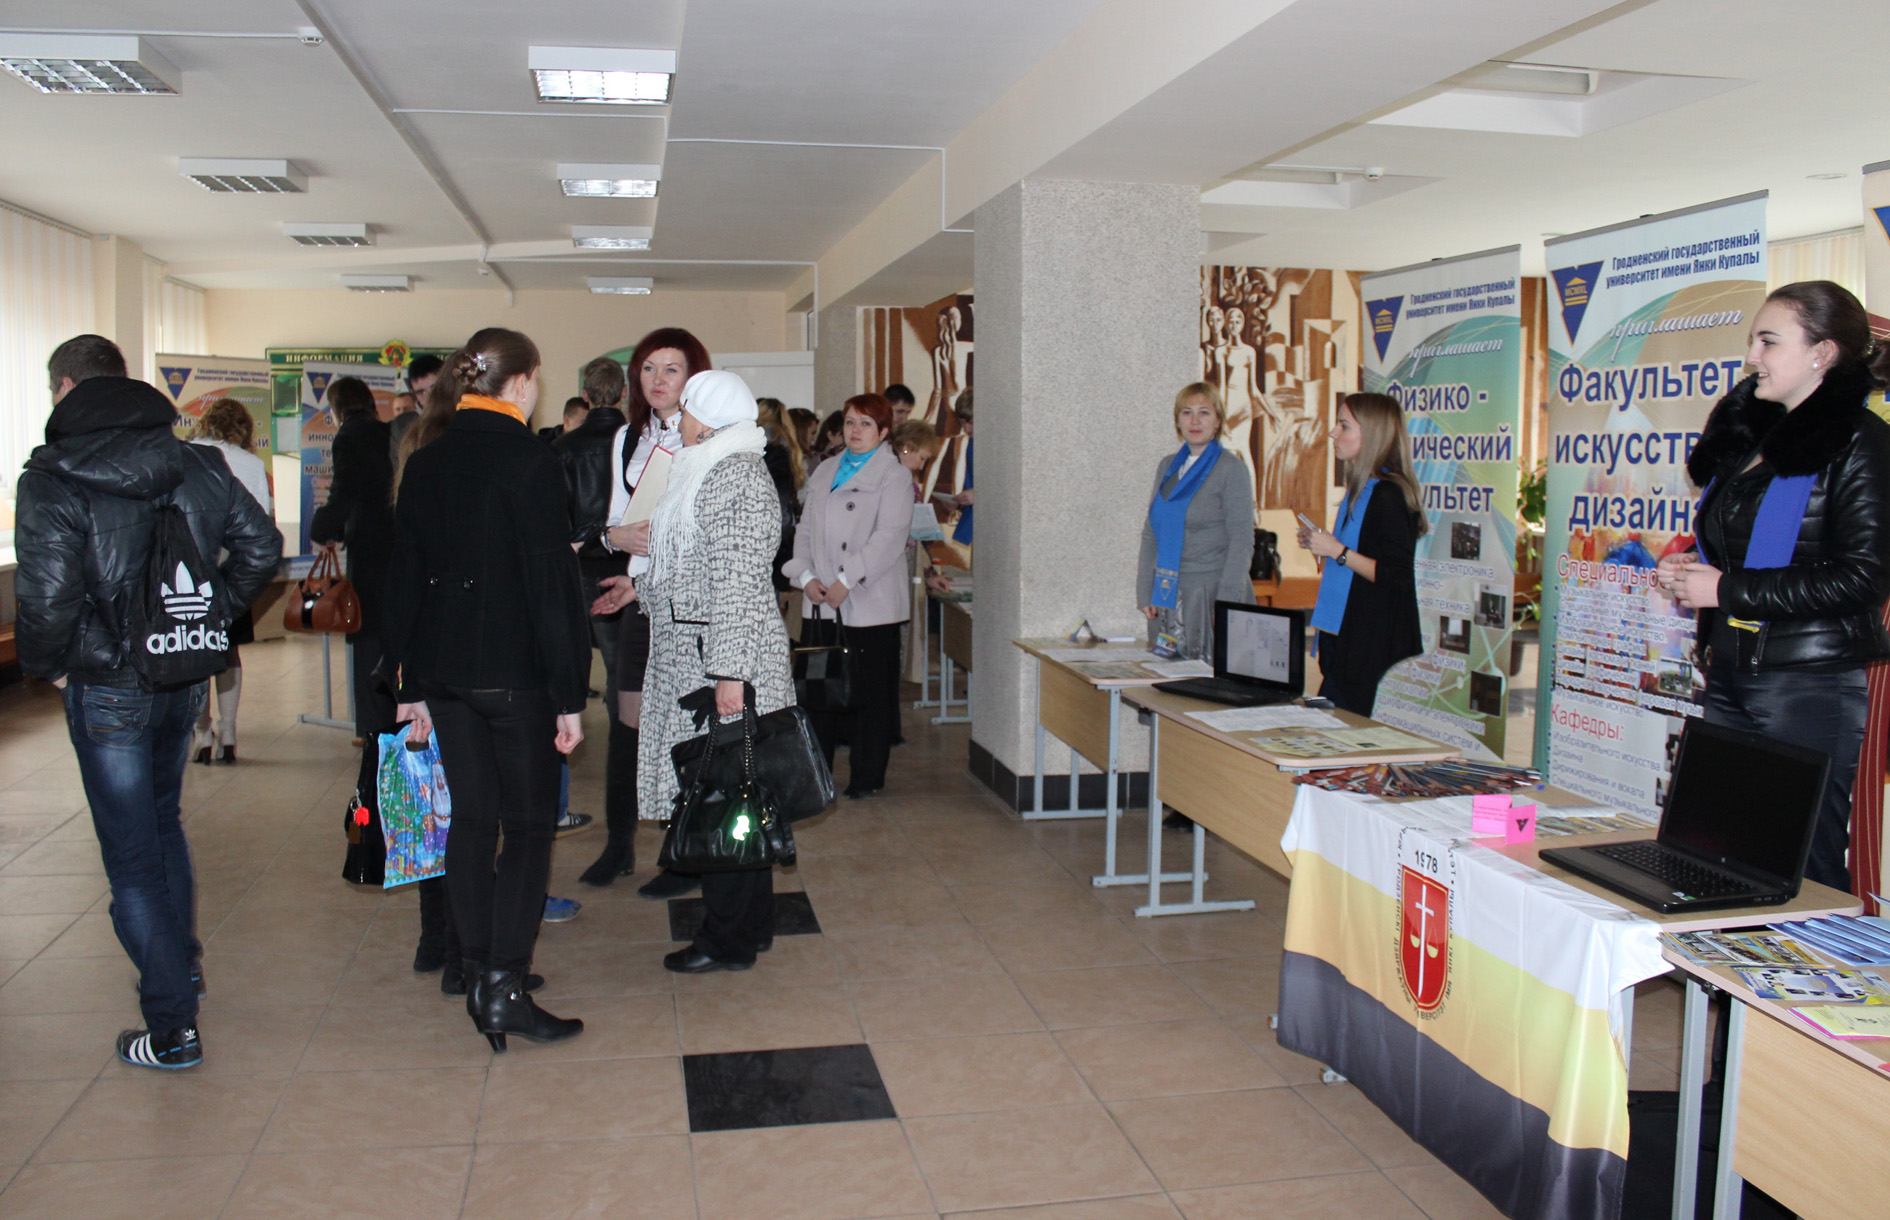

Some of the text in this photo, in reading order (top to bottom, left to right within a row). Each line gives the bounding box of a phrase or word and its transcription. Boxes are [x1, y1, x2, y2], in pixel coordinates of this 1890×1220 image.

[1612, 229, 1760, 270] Гродненский государственный
[1606, 251, 1760, 289] университет имени Янки Купалы
[1610, 309, 1744, 363] приглашает
[285, 353, 364, 364] ИНФОРМАЦИЯ
[1387, 382, 1470, 412] Физико
[1559, 359, 1742, 412] Факультет
[1413, 424, 1512, 461] ический
[1557, 554, 1666, 590] Специально
[146, 623, 229, 655] adidas
[1551, 703, 1625, 742] Кафедры:
[1415, 849, 1438, 874] 1978
